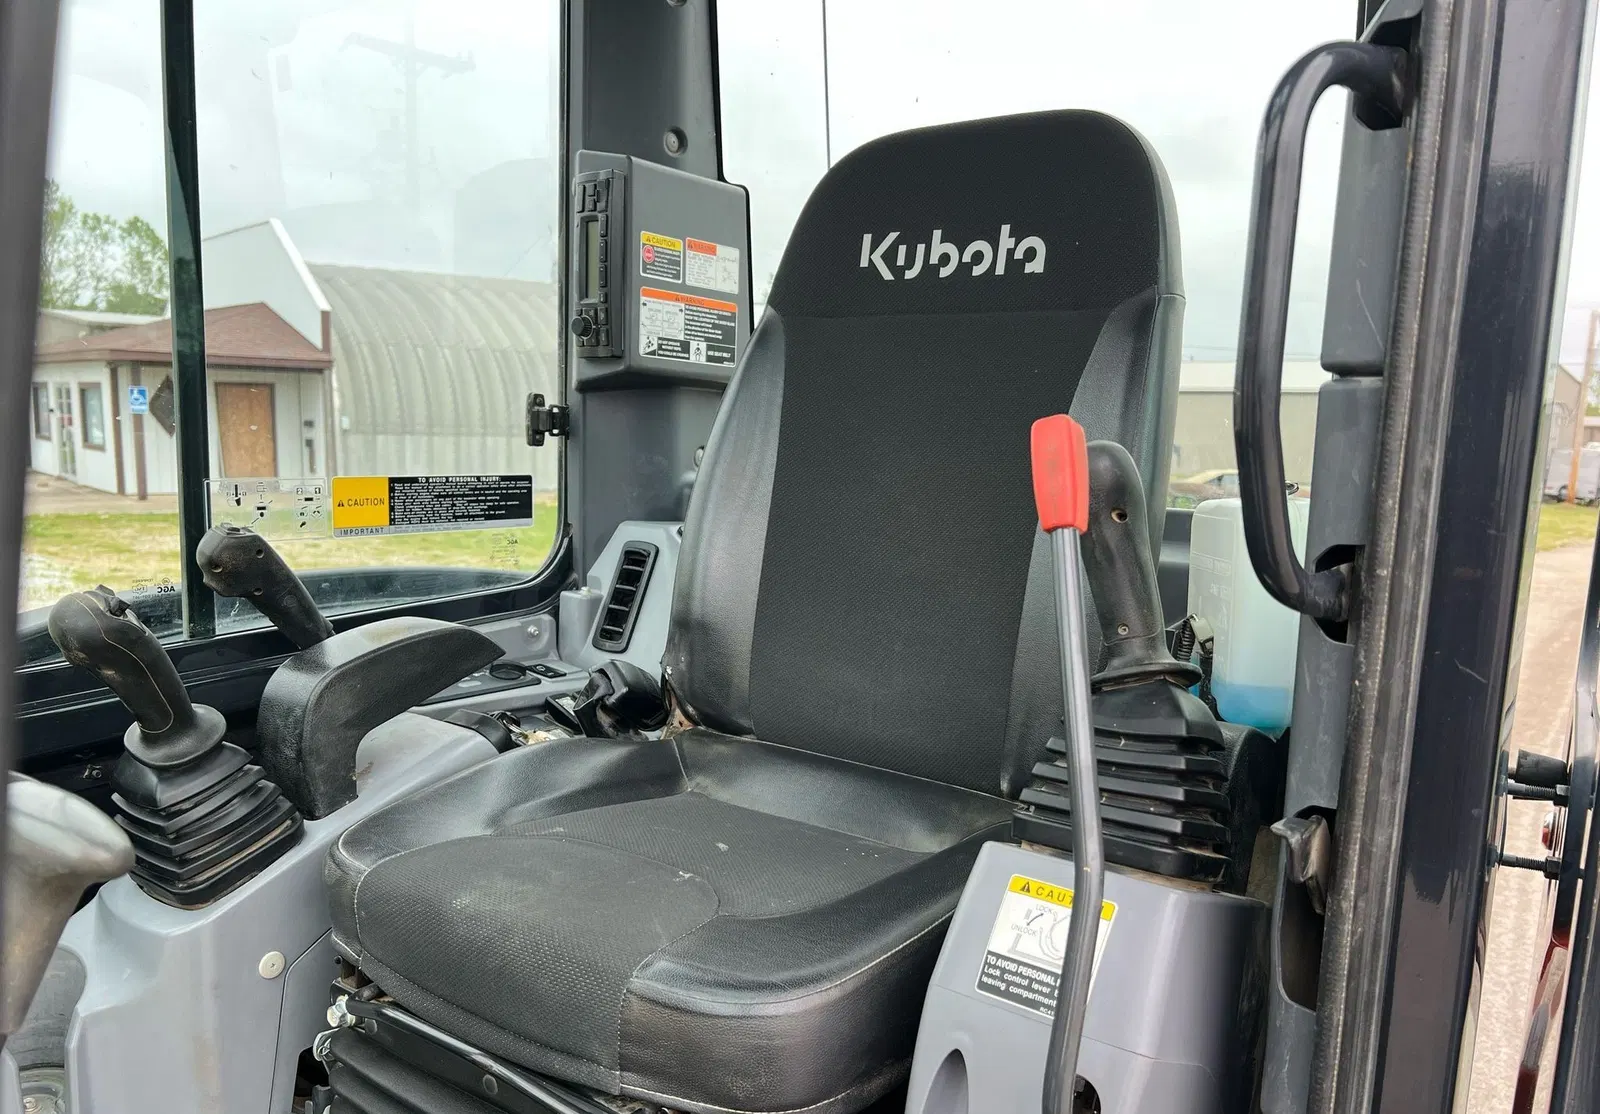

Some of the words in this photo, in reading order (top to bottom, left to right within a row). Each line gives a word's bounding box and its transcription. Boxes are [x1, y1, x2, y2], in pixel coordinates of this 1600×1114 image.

[652, 236, 676, 248] CAUTION
[859, 224, 1047, 281] Kubota
[347, 497, 385, 507] CAUTION
[340, 527, 385, 536] IMPORTANT
[1035, 904, 1053, 914] LOCK
[1010, 923, 1037, 937] UNLOCK
[986, 955, 996, 964] TO
[995, 958, 1019, 972] AVOID
[1018, 965, 1056, 986] PERSONAL
[984, 965, 1001, 977] Lock
[1003, 973, 1029, 987] control
[1031, 980, 1051, 994] lever
[981, 974, 1006, 991] leaving
[1008, 985, 1057, 1008] compartment
